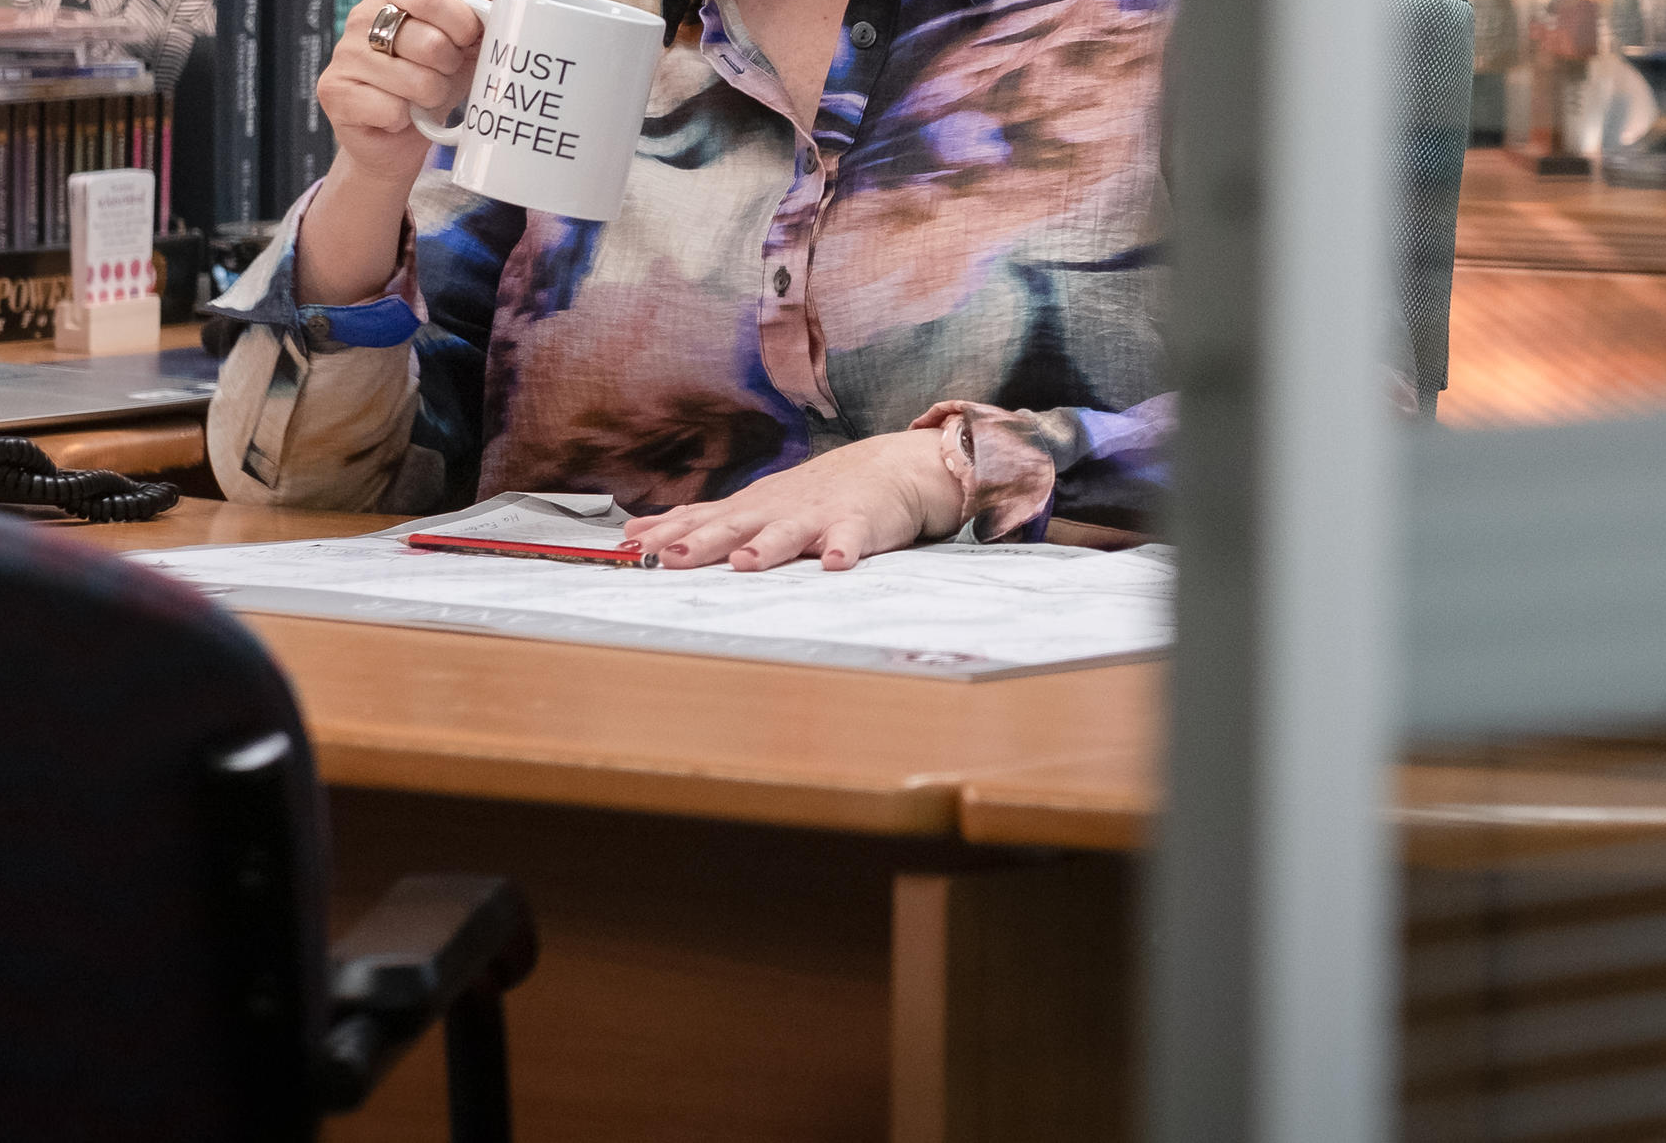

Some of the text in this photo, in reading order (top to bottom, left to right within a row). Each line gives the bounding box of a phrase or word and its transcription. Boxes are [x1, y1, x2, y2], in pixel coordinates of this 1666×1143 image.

[489, 39, 577, 85] MUST
[483, 74, 564, 120] HAVE
[465, 104, 581, 160] COFFEE
